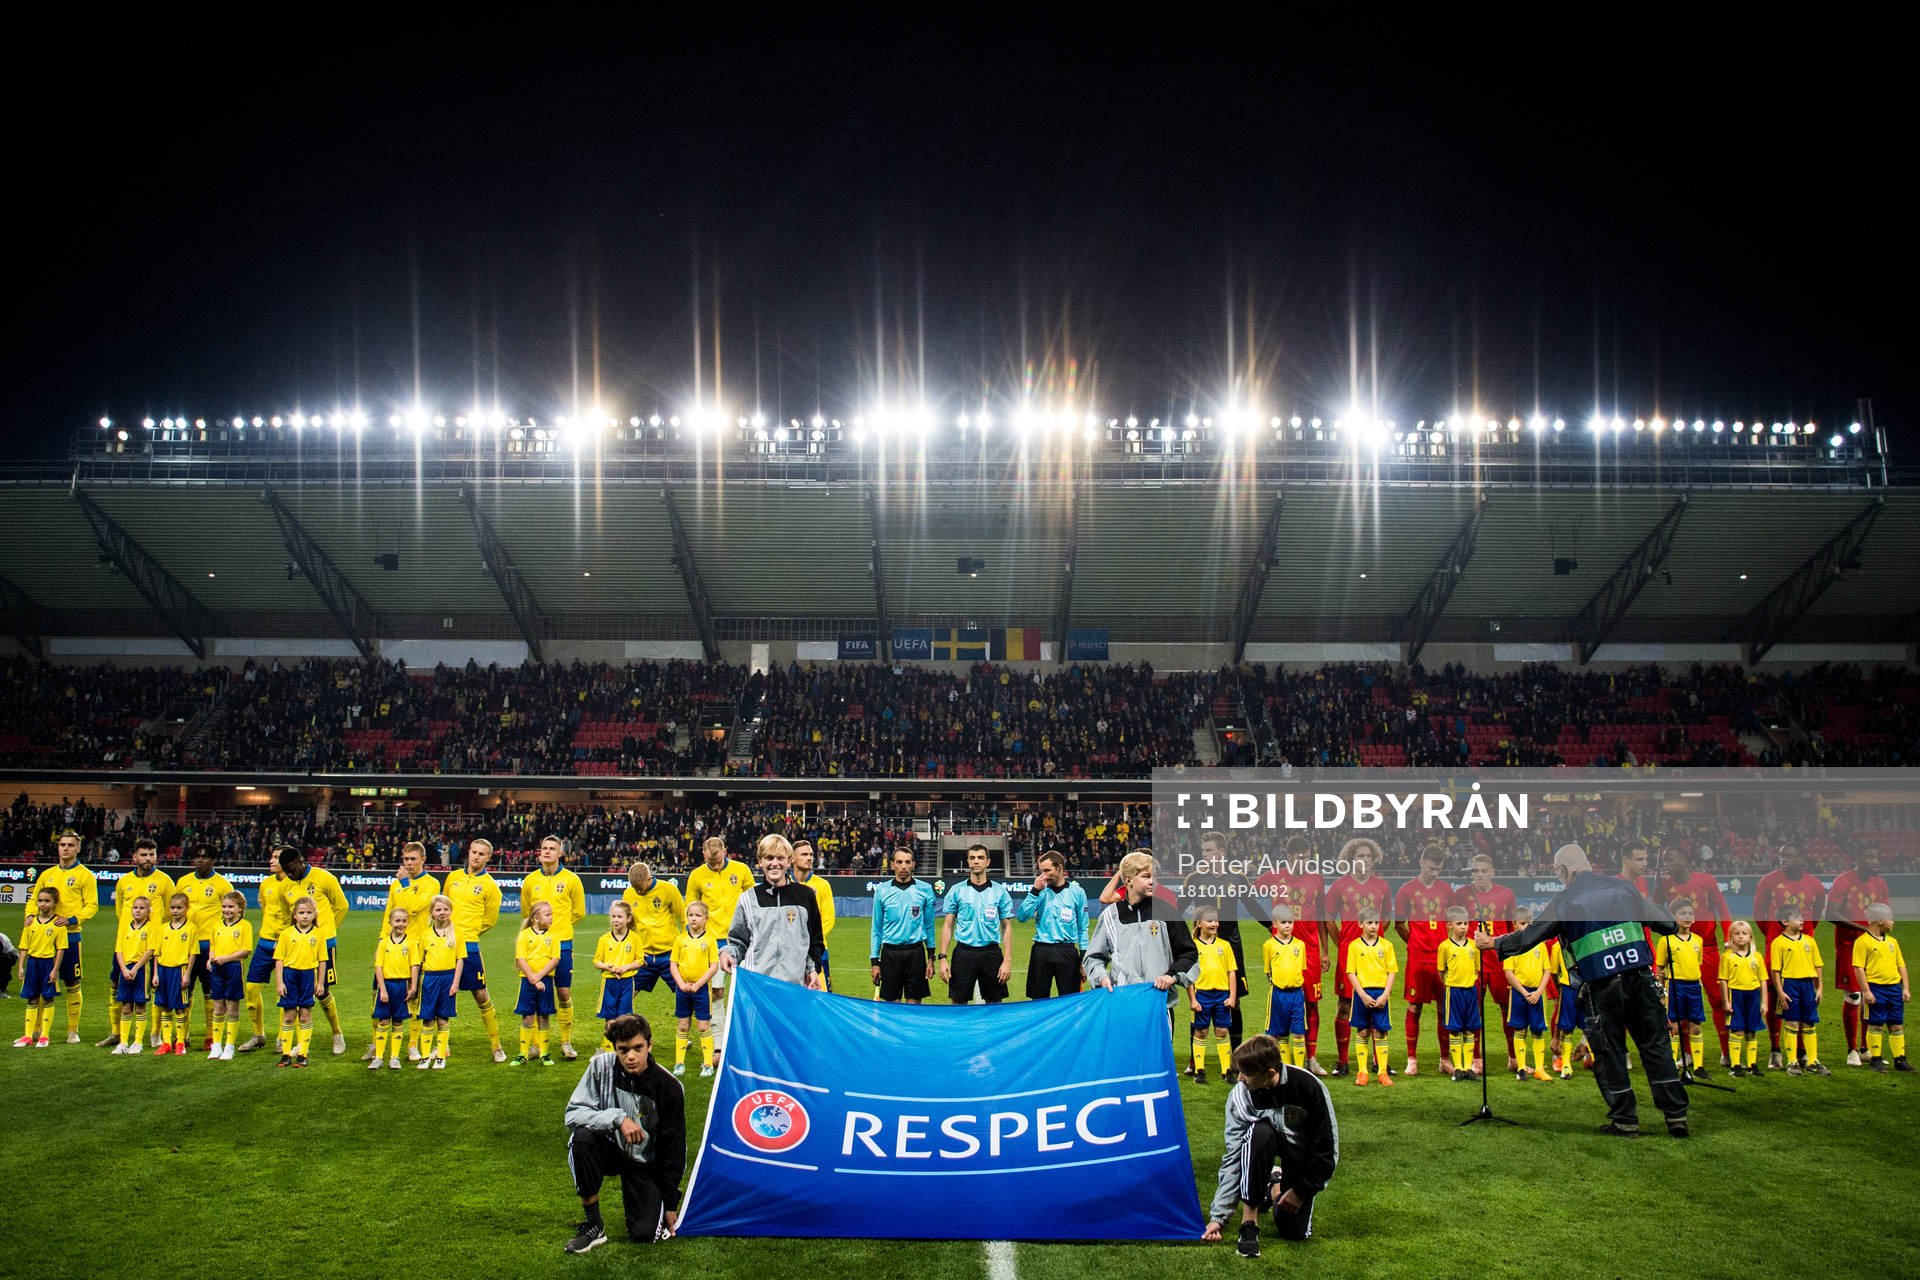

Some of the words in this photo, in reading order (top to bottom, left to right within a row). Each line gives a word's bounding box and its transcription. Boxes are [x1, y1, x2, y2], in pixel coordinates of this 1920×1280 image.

[845, 640, 869, 649] FIFA
[893, 639, 928, 649] UEFA
[962, 793, 985, 801] PUB
[0, 893, 13, 903] US
[1602, 928, 1626, 946] HB
[1603, 948, 1639, 970] 019
[74, 963, 81, 977] 6
[327, 968, 335, 983] 8
[477, 971, 485, 985] 4
[1241, 976, 1248, 991] 1
[751, 1093, 796, 1112] UEFA
[841, 1089, 1170, 1160] RESPECT
